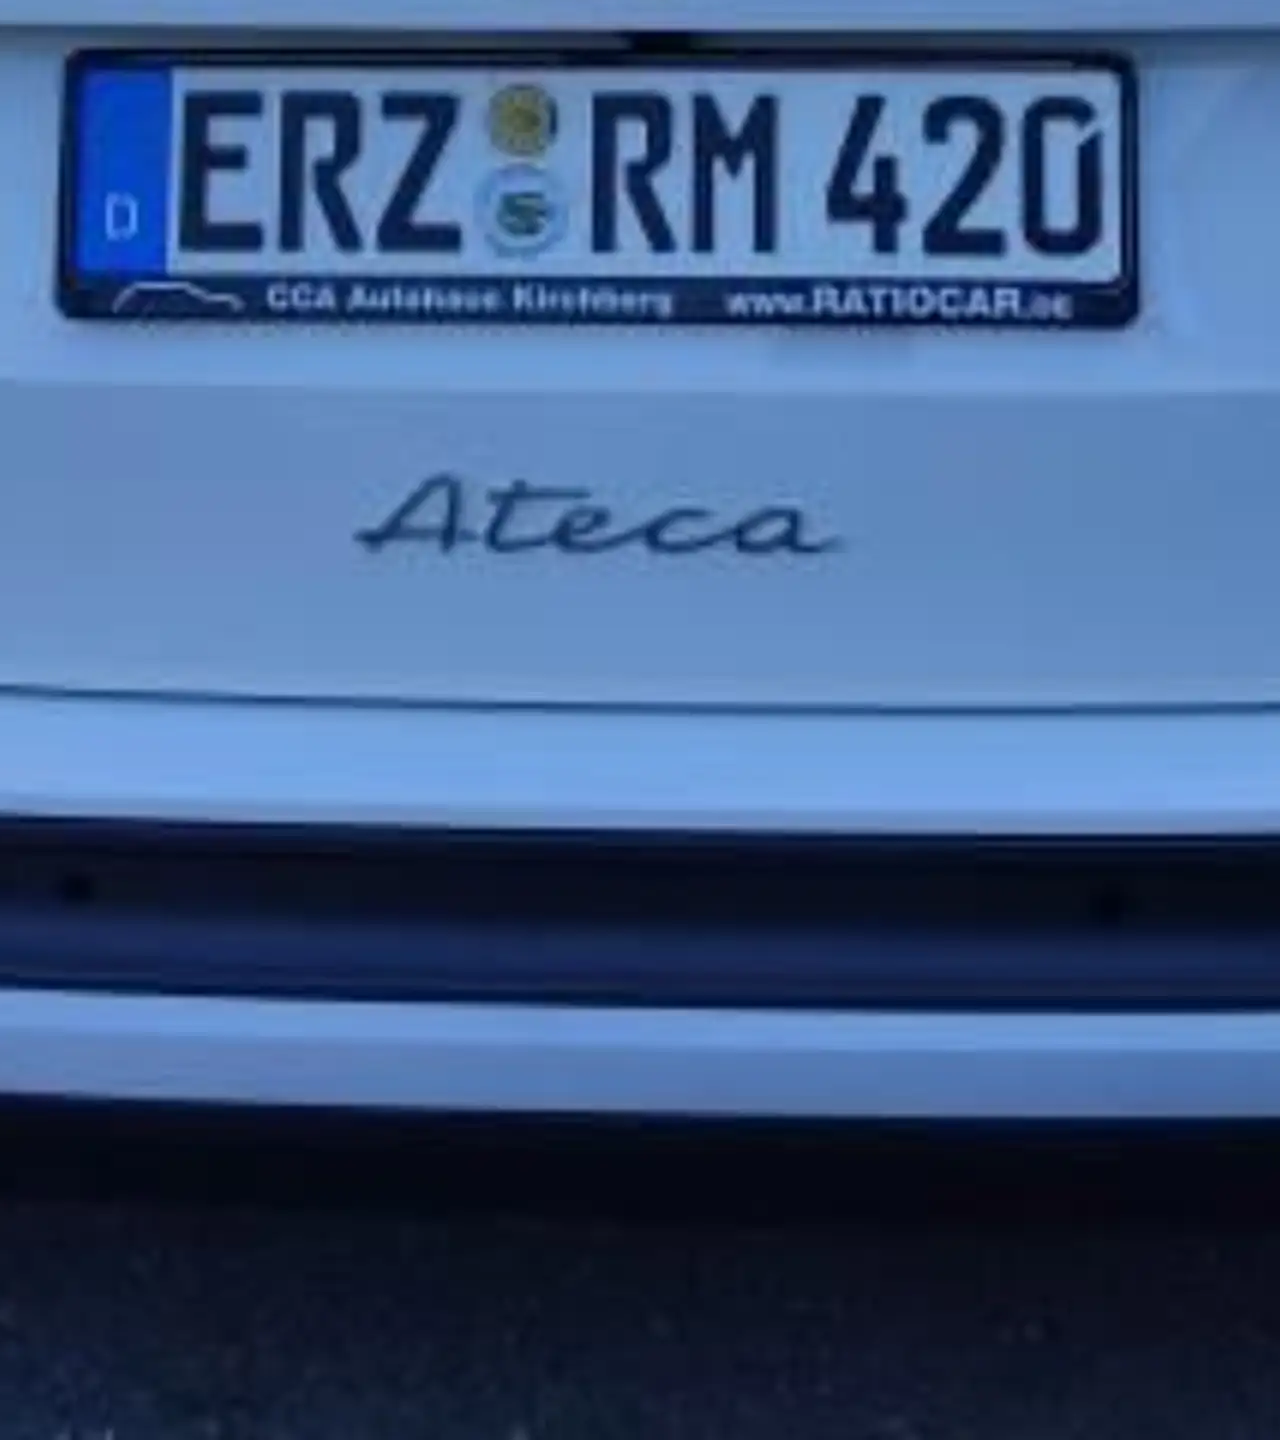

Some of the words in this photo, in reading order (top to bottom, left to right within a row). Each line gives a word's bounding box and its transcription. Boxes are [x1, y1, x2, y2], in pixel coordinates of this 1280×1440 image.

[178, 90, 463, 254] ERZ
[590, 92, 778, 254] RM
[825, 94, 1104, 257] 420
[104, 192, 138, 241] D
[265, 280, 337, 313] CCA
[352, 472, 845, 556] Ateca
